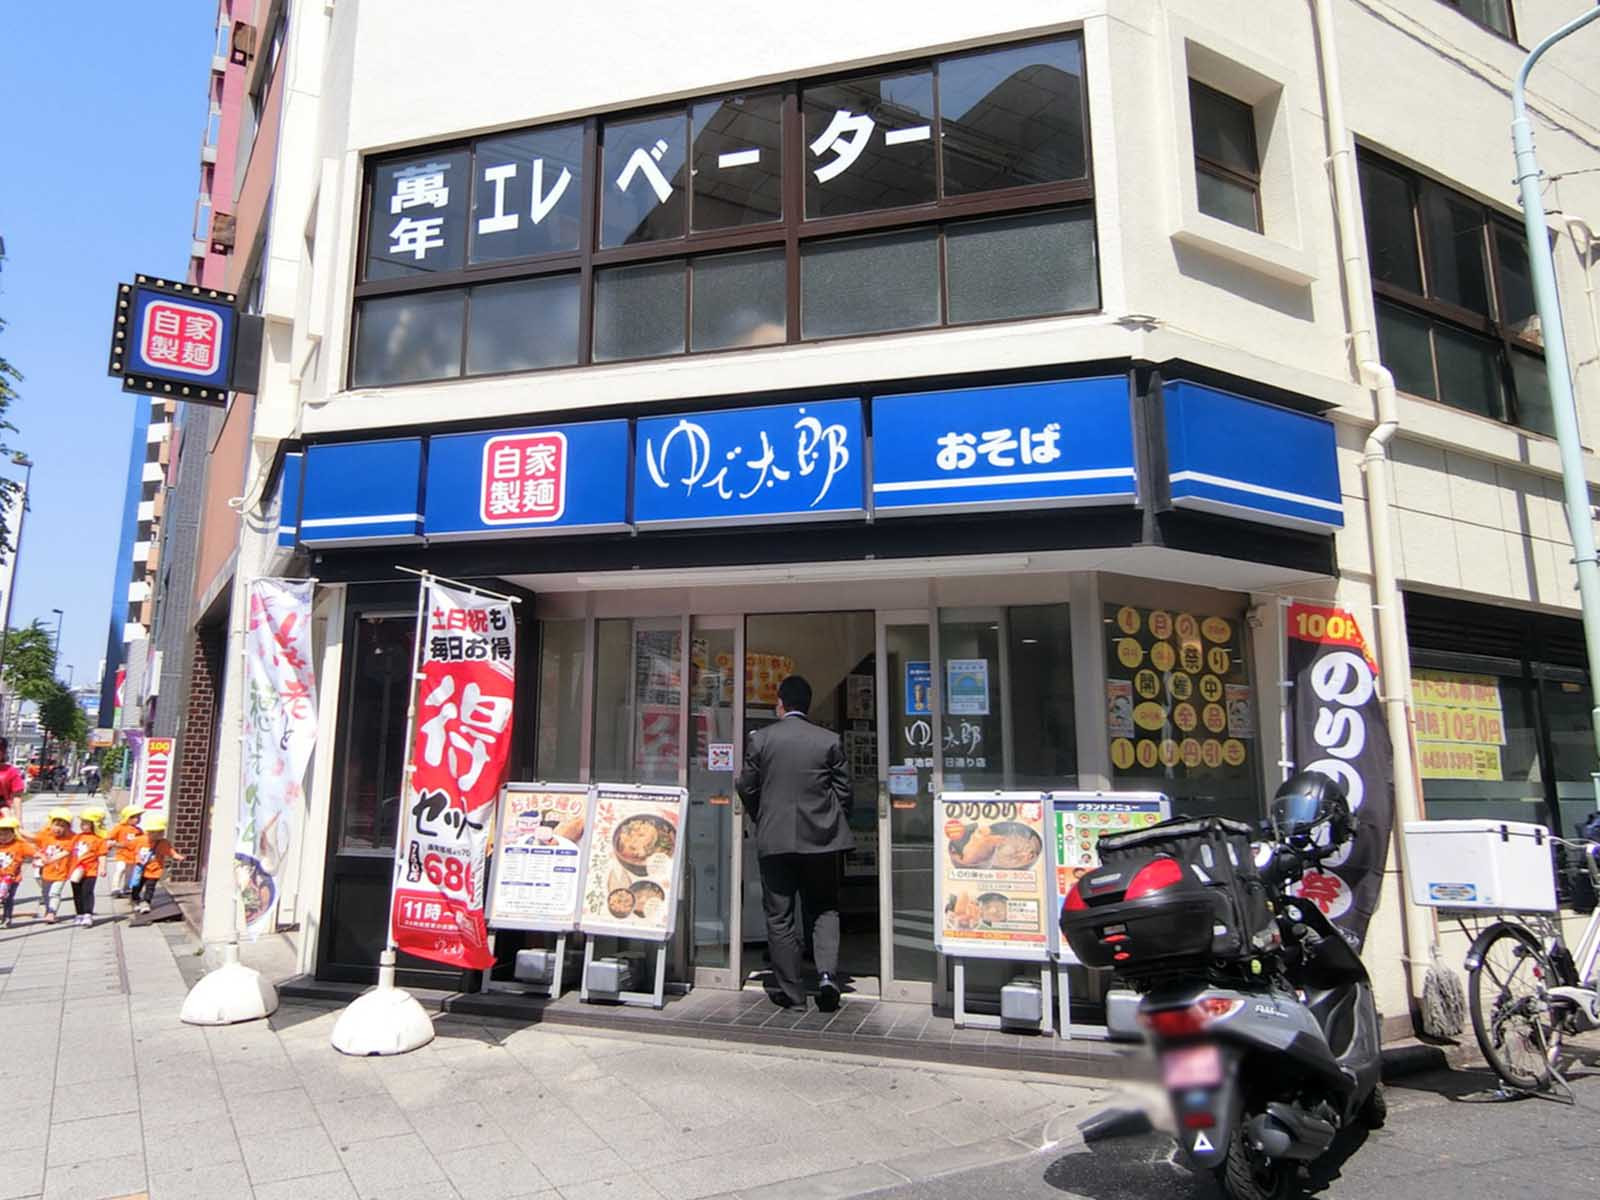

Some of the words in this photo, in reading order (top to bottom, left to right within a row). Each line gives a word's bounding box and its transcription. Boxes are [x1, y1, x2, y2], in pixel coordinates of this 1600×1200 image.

[478, 110, 931, 235] エレベーター
[389, 163, 449, 260] 萬年
[155, 311, 214, 341] 自家
[151, 335, 211, 367] 製麺
[494, 443, 557, 479] 自家
[936, 422, 1062, 470] おそば
[489, 479, 556, 514] 製麺
[431, 606, 507, 632] 土日祝も
[430, 636, 512, 661] 毎日お得
[421, 675, 513, 792] 得
[904, 720, 981, 754] ゆ太郎
[412, 791, 483, 839] セット
